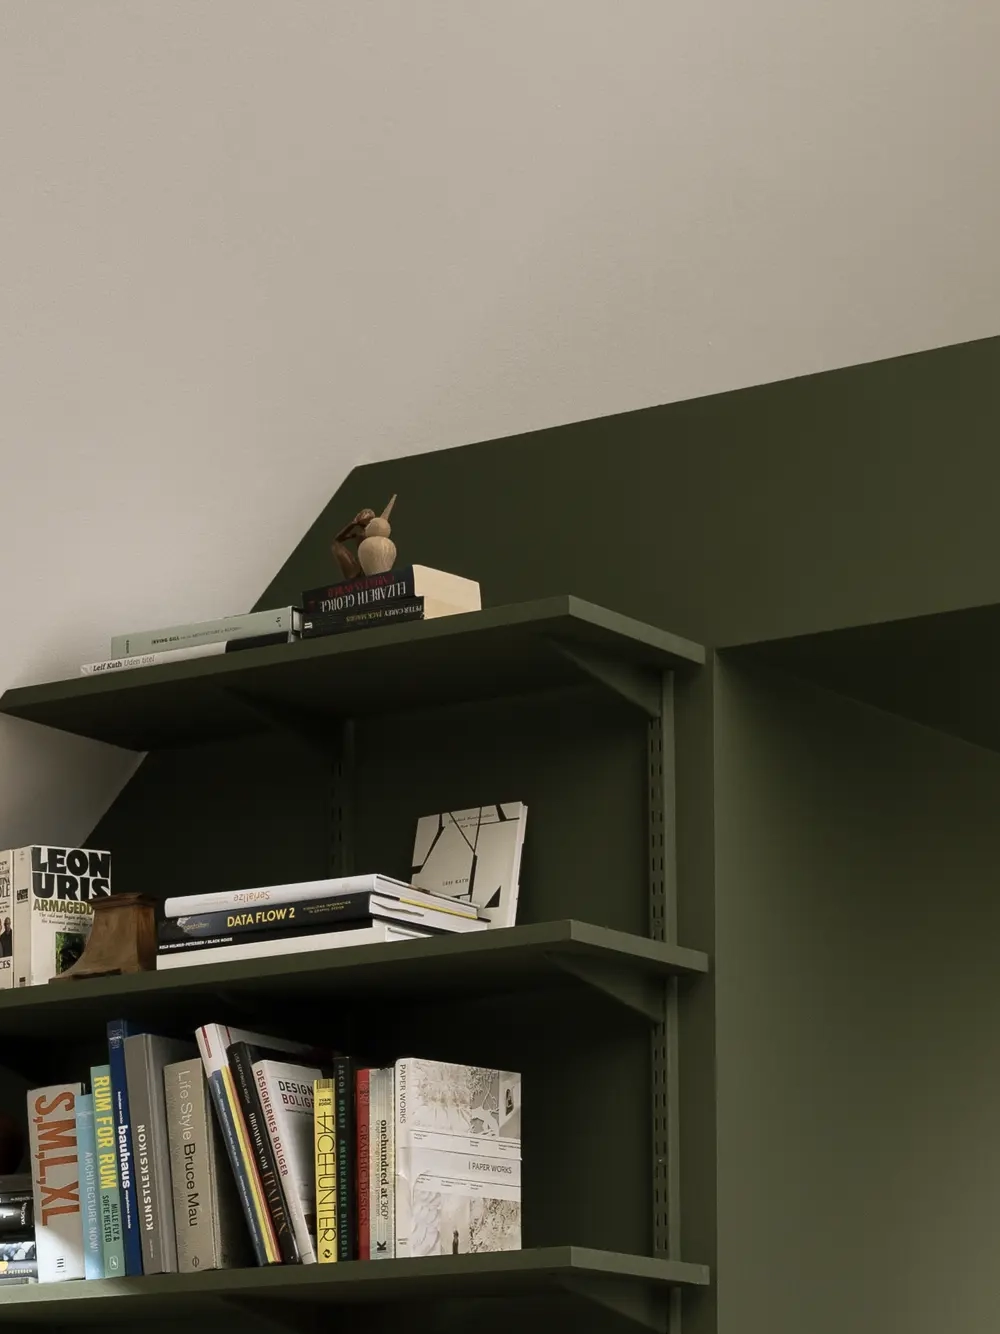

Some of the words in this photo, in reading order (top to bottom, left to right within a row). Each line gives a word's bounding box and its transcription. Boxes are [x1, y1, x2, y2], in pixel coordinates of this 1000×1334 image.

[319, 593, 355, 613] GEORGE
[357, 581, 407, 605] ELIZABETH
[383, 607, 403, 617] CAREY
[403, 604, 422, 614] PETER
[123, 658, 141, 668] Uden
[31, 847, 111, 878] LEON
[32, 873, 111, 902] URIS
[233, 890, 270, 905] Serialize
[226, 911, 254, 928] DATA
[255, 909, 287, 924] FLOW
[288, 907, 296, 919] 2
[93, 1075, 111, 1112] RUM
[177, 1070, 191, 1099] Life
[179, 1100, 194, 1141] Style
[255, 1069, 278, 1133] DESIGNERNES
[273, 1136, 289, 1177] BOLIGER
[338, 1099, 346, 1129] HOLDT
[399, 1091, 407, 1124] WORKS
[97, 1115, 115, 1149] FOR
[33, 1091, 80, 1227] S,M,L,XL
[117, 1125, 132, 1189] bauhaus
[182, 1142, 196, 1189] Bruce
[260, 1155, 269, 1170] OM
[359, 1123, 368, 1180] GRAPHIC
[380, 1119, 388, 1185] onehundred
[99, 1152, 117, 1190] RUM
[137, 1124, 154, 1231] KUNSTLEKSIKON
[316, 1111, 337, 1244] FACEHUNTER
[339, 1139, 347, 1208] AMERIKANSKE
[472, 1163, 490, 1173] PAPER
[491, 1164, 513, 1175] WORKS
[85, 1151, 98, 1225] ARCHITECTURE
[380, 1187, 388, 1199] at
[102, 1194, 110, 1216] SOFIE
[110, 1203, 118, 1221] MILLE
[186, 1192, 199, 1227] Mau
[359, 1182, 368, 1226] DESIGN
[90, 1225, 98, 1252] NOW!
[103, 1216, 112, 1243] HELSTED
